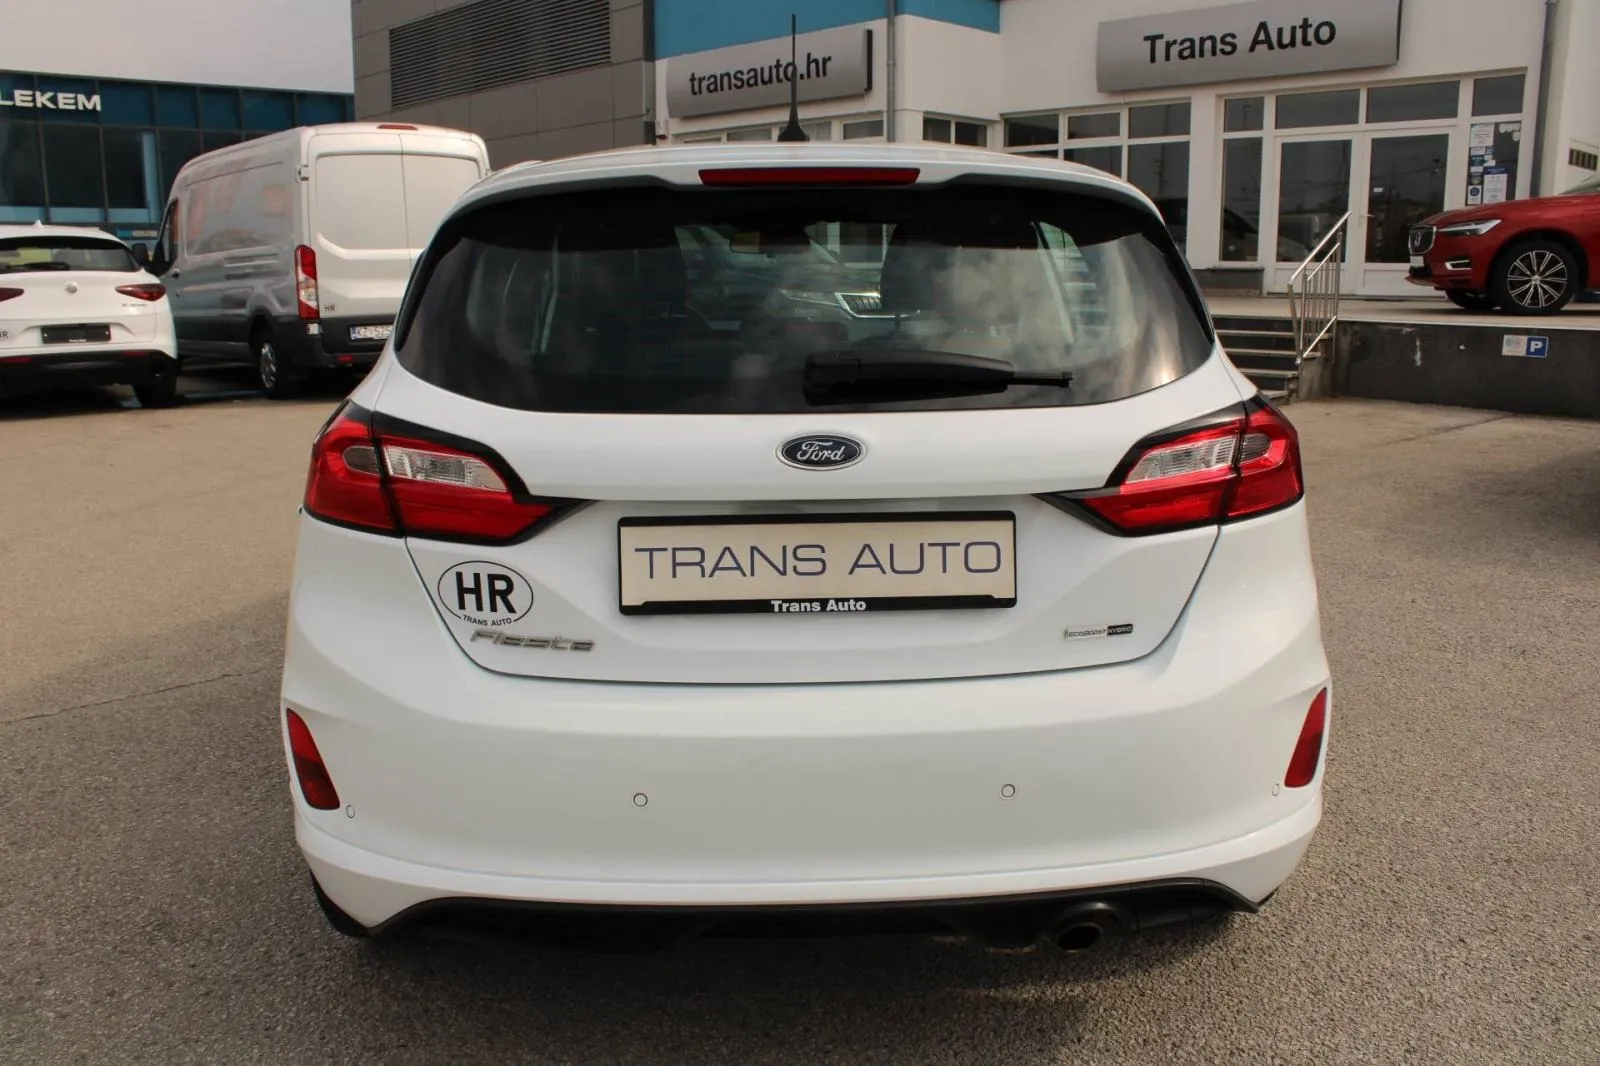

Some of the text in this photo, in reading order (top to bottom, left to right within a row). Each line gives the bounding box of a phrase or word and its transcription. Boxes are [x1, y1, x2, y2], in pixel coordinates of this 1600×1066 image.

[1143, 17, 1337, 64] Trans Auto
[689, 52, 832, 96] transauto.hr
[1529, 340, 1544, 353] P
[796, 441, 845, 460] Ford
[635, 541, 1002, 579] TRANS AUTO
[455, 571, 517, 614] HR
[770, 599, 867, 613] Trans Auto
[462, 614, 513, 626] TRANS AUTO
[470, 629, 596, 651] Fiesta
